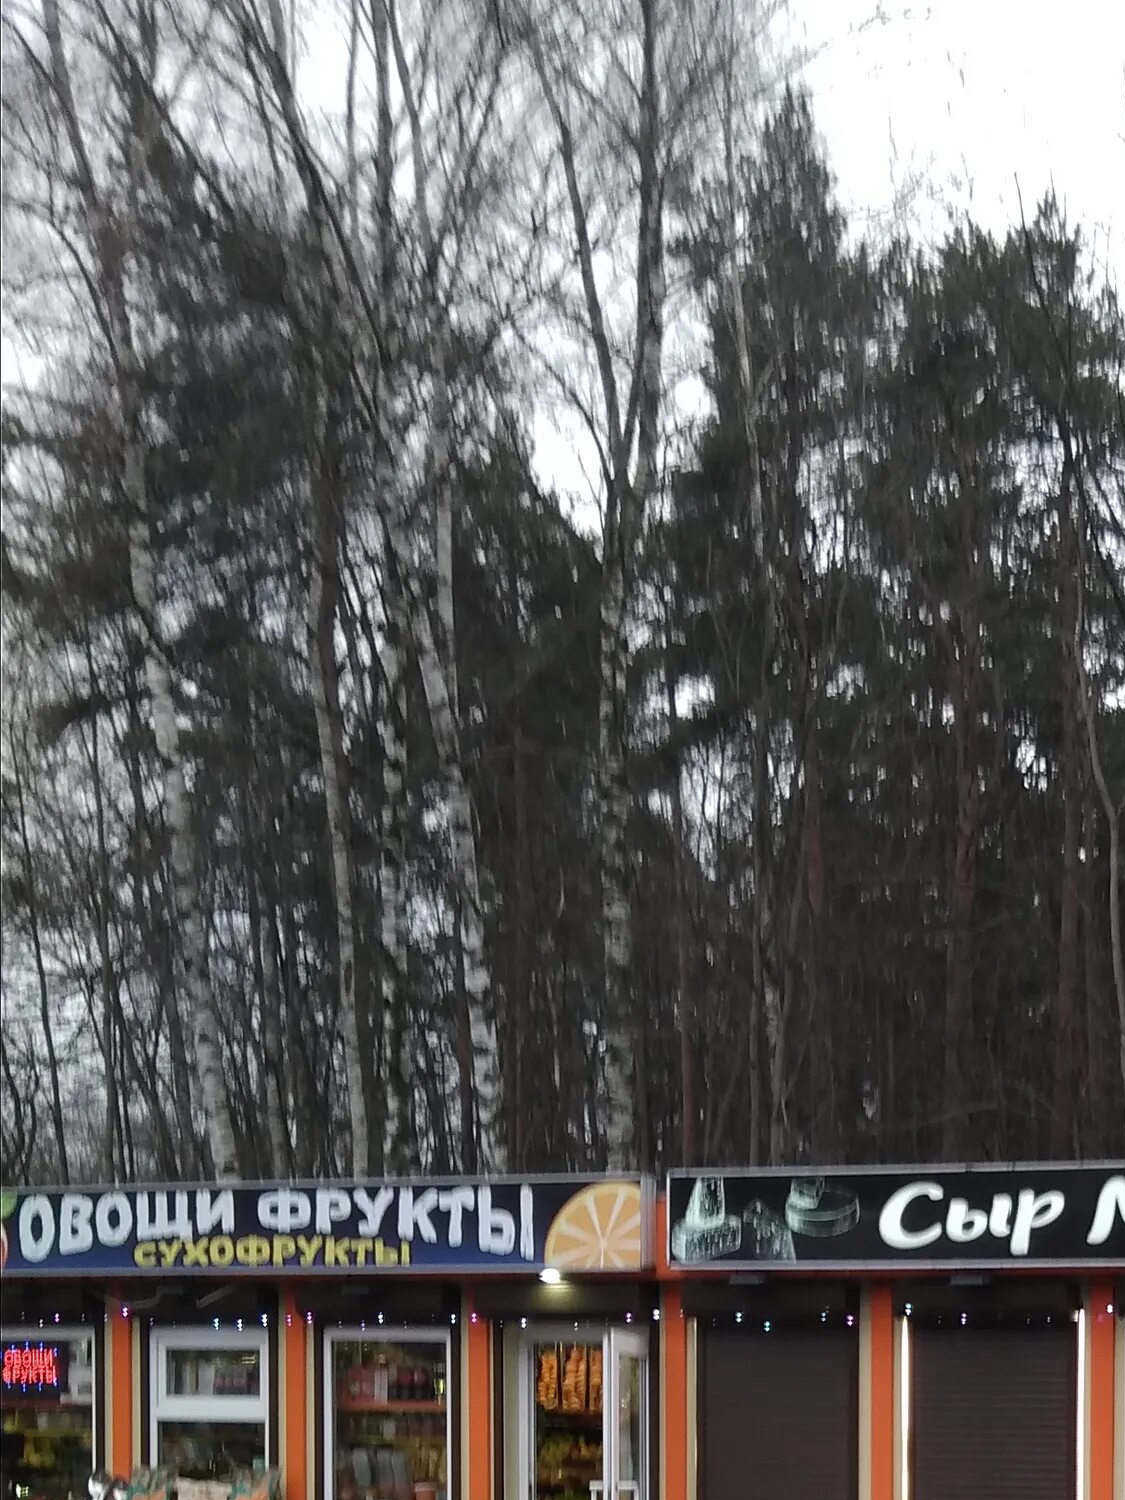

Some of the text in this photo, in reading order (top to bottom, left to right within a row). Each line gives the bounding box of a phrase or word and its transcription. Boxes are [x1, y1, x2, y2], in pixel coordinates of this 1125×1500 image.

[18, 1184, 535, 1263] ОВОЩИ ФРУКТЫ
[878, 1181, 1064, 1257] Сыр
[133, 1234, 411, 1268] СУХОФРУКТЫ
[2, 1365, 56, 1384] ФРУКТЫ
[4, 1348, 53, 1367] ОВОЩИ
